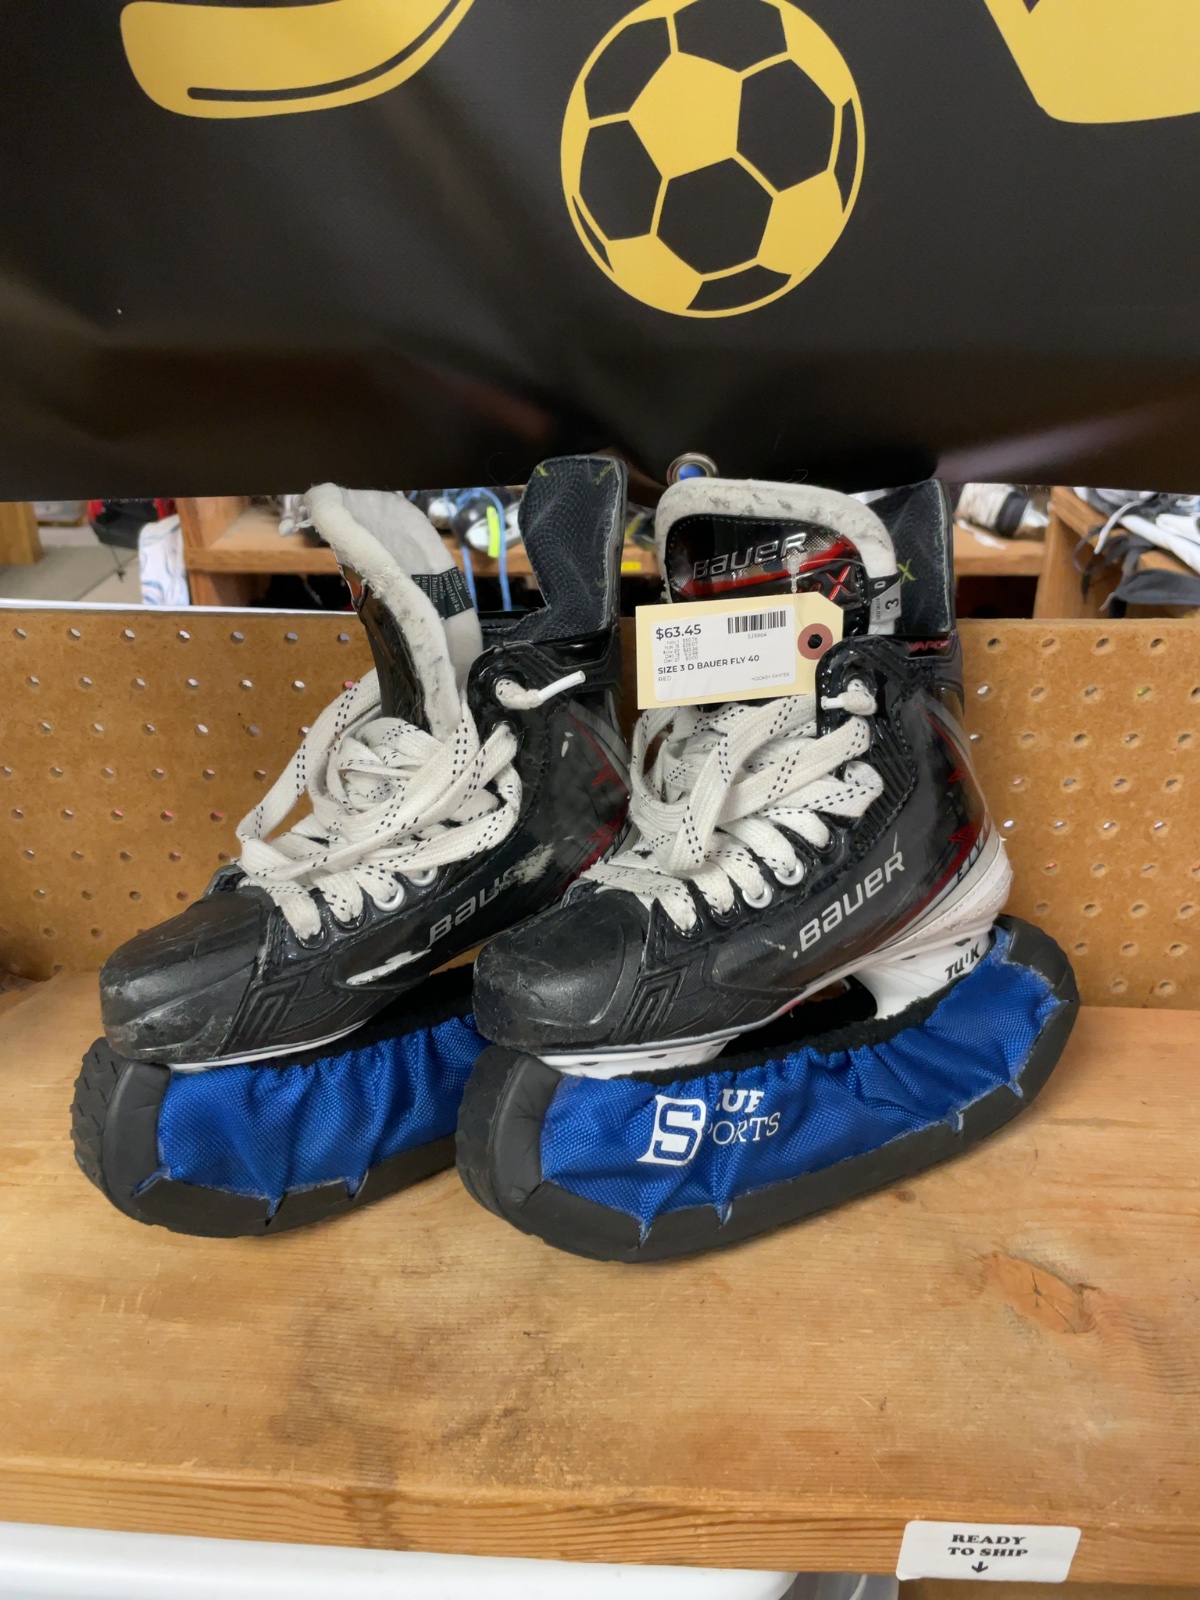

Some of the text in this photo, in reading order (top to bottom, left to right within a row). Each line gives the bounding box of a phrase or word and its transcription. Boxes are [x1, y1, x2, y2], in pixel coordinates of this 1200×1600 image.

[693, 532, 806, 579] BAUER
[885, 598, 899, 610] 3
[656, 624, 702, 641] $63.45
[658, 654, 760, 675] SIZE 3 D BAUER FLY 40
[799, 851, 905, 952] BAUER
[951, 1534, 1027, 1545] READY
[948, 1547, 1029, 1557] TO SHIP
